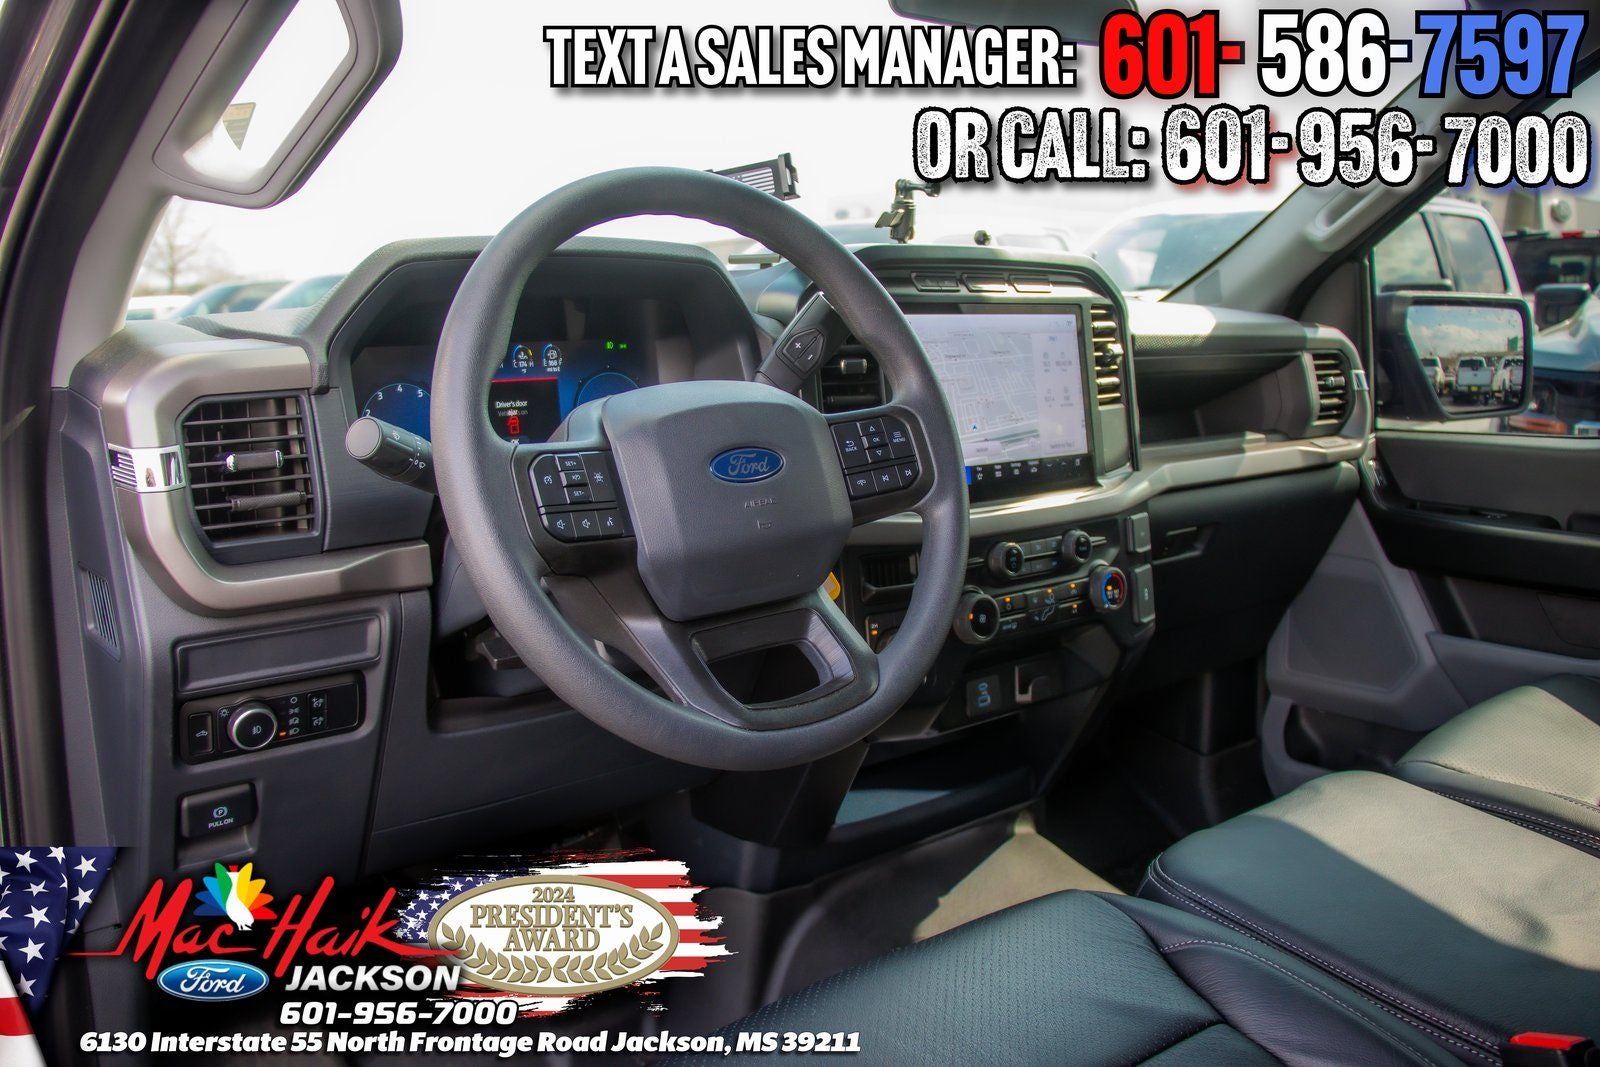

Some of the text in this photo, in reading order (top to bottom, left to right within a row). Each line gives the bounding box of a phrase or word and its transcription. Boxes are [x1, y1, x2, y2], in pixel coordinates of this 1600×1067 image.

[378, 392, 383, 400] 3
[418, 389, 423, 398] 5
[728, 453, 770, 476] Ford
